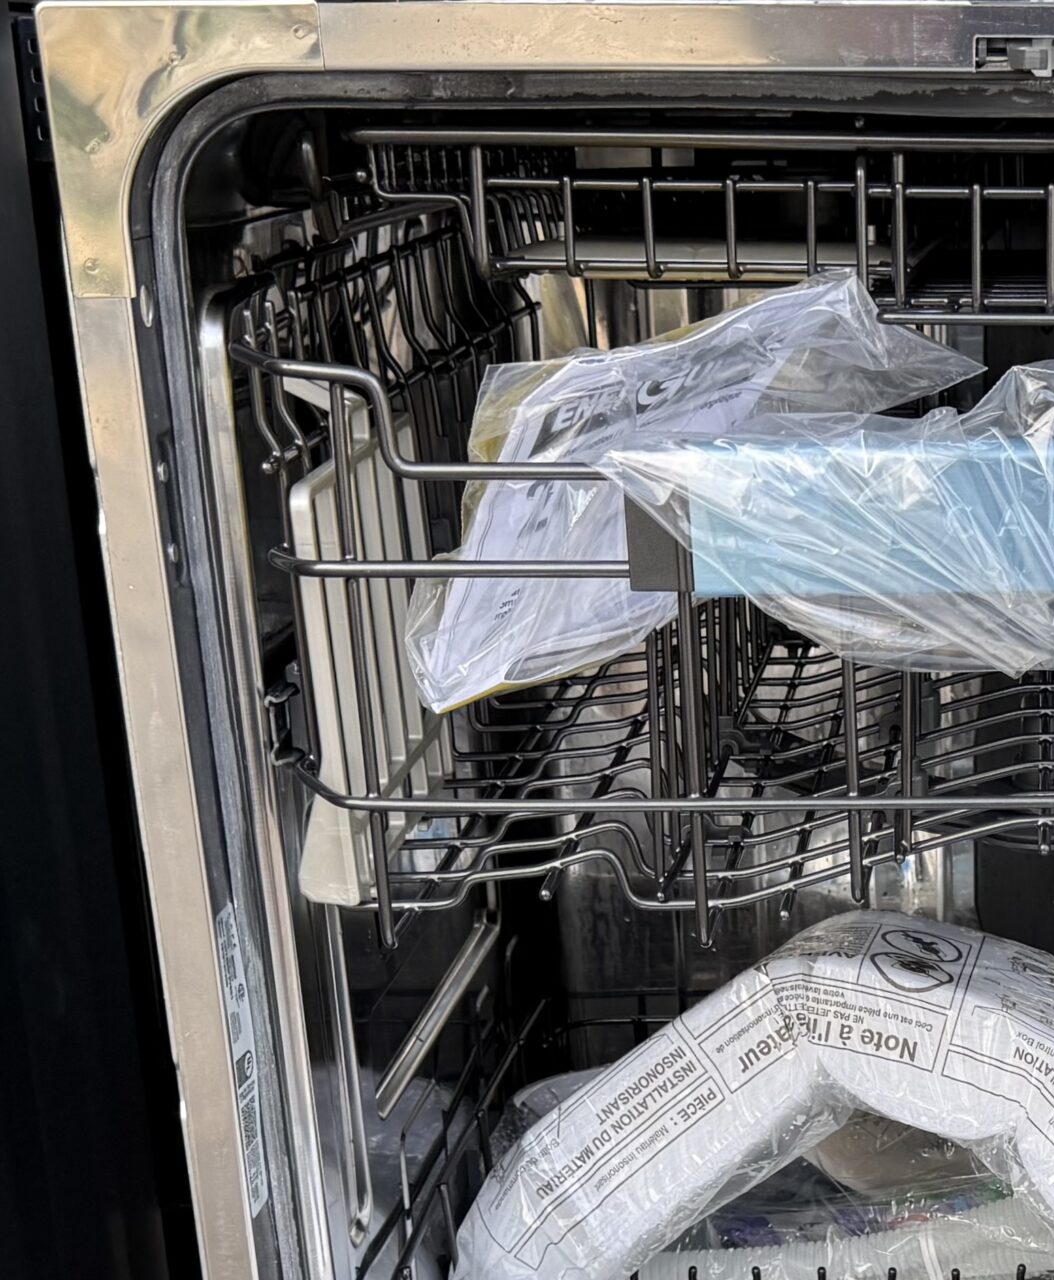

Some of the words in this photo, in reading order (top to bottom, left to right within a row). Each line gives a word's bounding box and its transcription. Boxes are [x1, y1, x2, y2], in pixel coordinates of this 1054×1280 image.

[822, 988, 845, 998] votre
[832, 1009, 850, 1020] PAS
[851, 1013, 864, 1023] NE
[882, 1010, 898, 1020] une
[900, 1015, 913, 1025] est
[838, 1023, 853, 1045] à
[859, 1027, 917, 1061] Note
[1015, 1030, 1035, 1045] Box
[592, 1044, 687, 1125] INSONORISANT
[608, 1059, 698, 1133] INSTALLATION
[675, 1086, 717, 1124] PIÈCE
[590, 1127, 612, 1150] DU
[533, 1144, 594, 1201] MATÉRIAU
